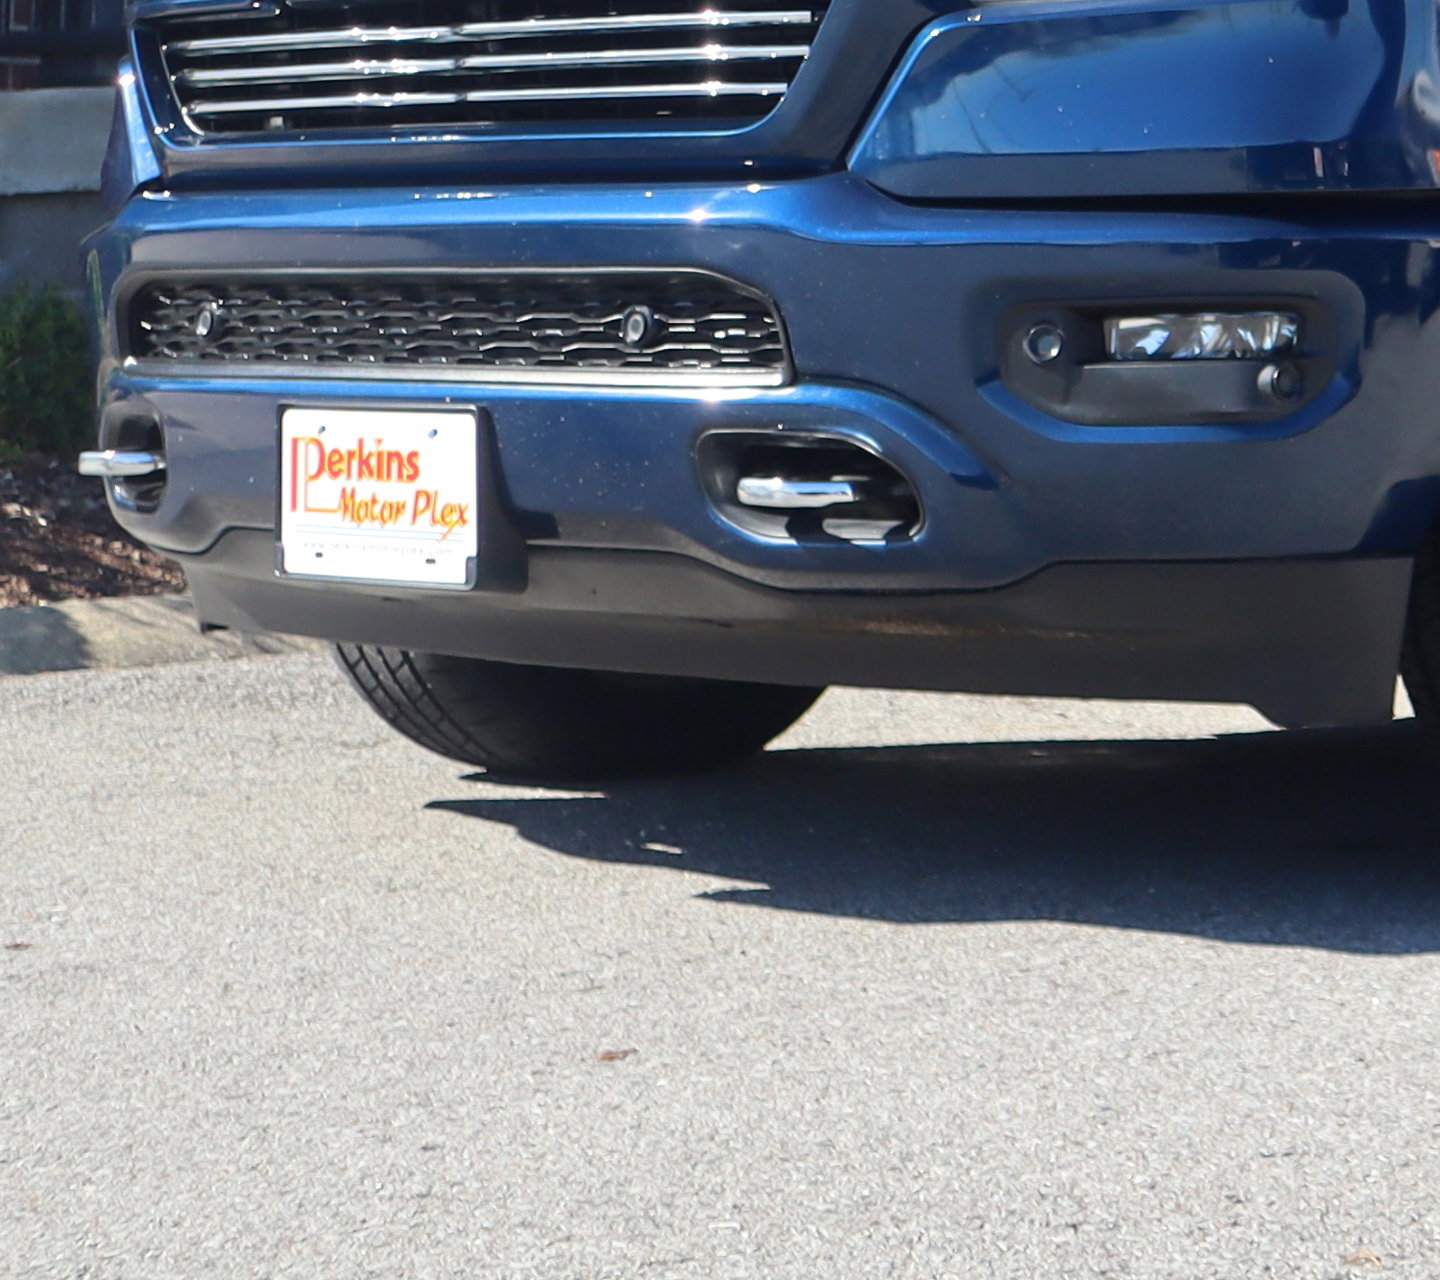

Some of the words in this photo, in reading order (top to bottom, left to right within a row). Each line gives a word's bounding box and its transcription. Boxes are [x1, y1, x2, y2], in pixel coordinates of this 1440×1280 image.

[290, 436, 420, 514] Perkins
[339, 486, 406, 527] Motor
[410, 488, 470, 543] Plex
